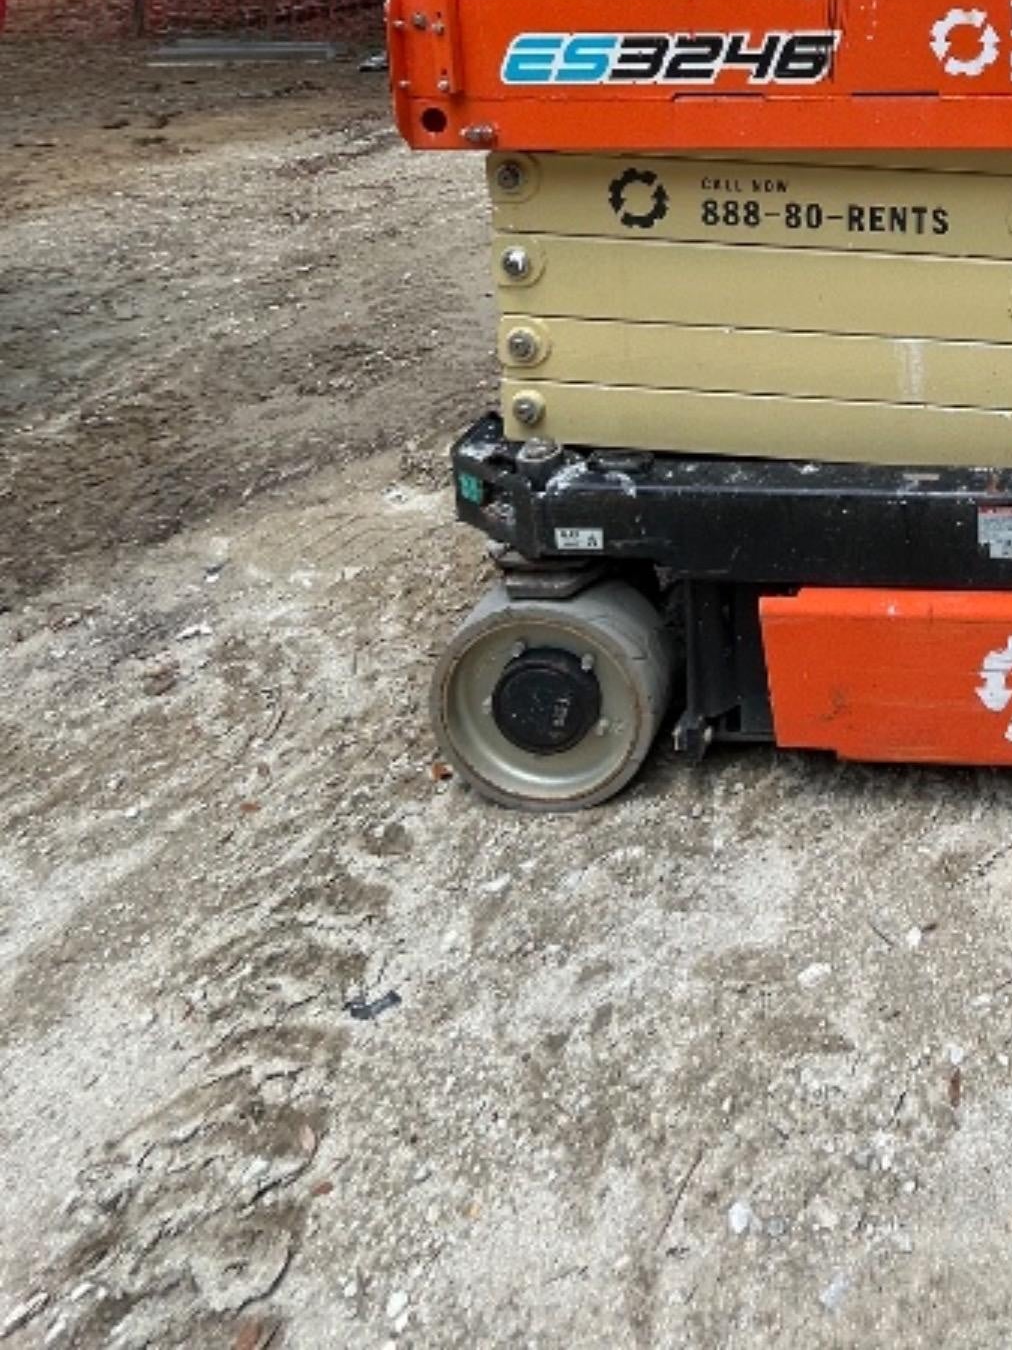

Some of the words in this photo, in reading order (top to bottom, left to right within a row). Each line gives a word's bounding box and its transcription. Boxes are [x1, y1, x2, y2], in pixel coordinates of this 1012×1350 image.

[501, 32, 842, 84] ES3246
[701, 177, 742, 192] CALL
[701, 200, 949, 235] 888-80-RENTS
